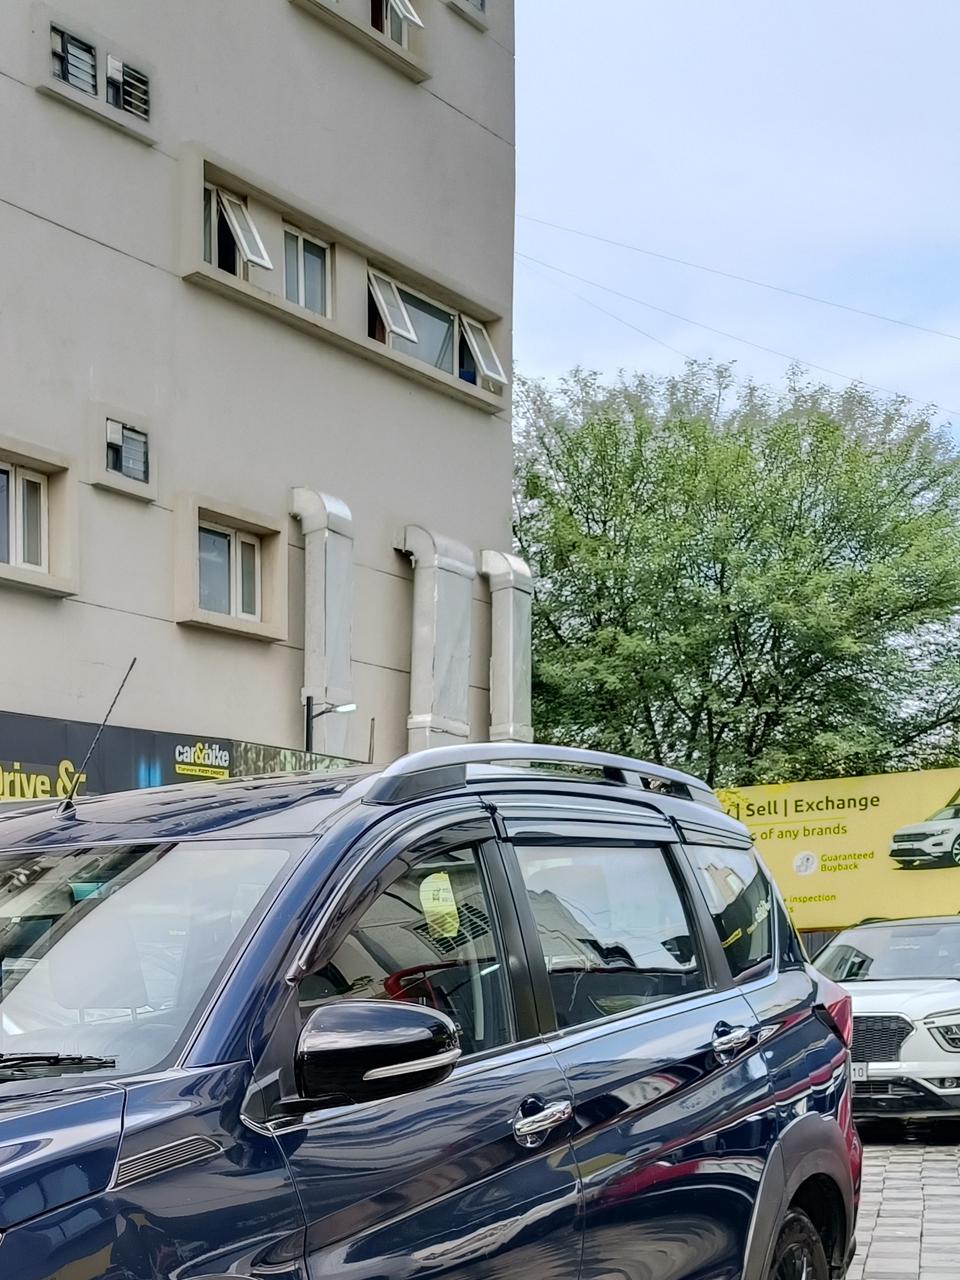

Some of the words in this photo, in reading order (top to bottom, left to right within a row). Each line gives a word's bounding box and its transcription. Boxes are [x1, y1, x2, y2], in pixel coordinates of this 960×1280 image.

[175, 742, 230, 767] car&bike
[56, 760, 86, 799] &
[746, 801, 778, 817] Sell
[794, 796, 880, 814] Exchange
[760, 828, 774, 840] of
[777, 829, 799, 841] any
[803, 824, 847, 838] brands
[820, 851, 874, 862] Guaranteed
[820, 863, 858, 873] Buyback
[789, 894, 836, 904] inspection
